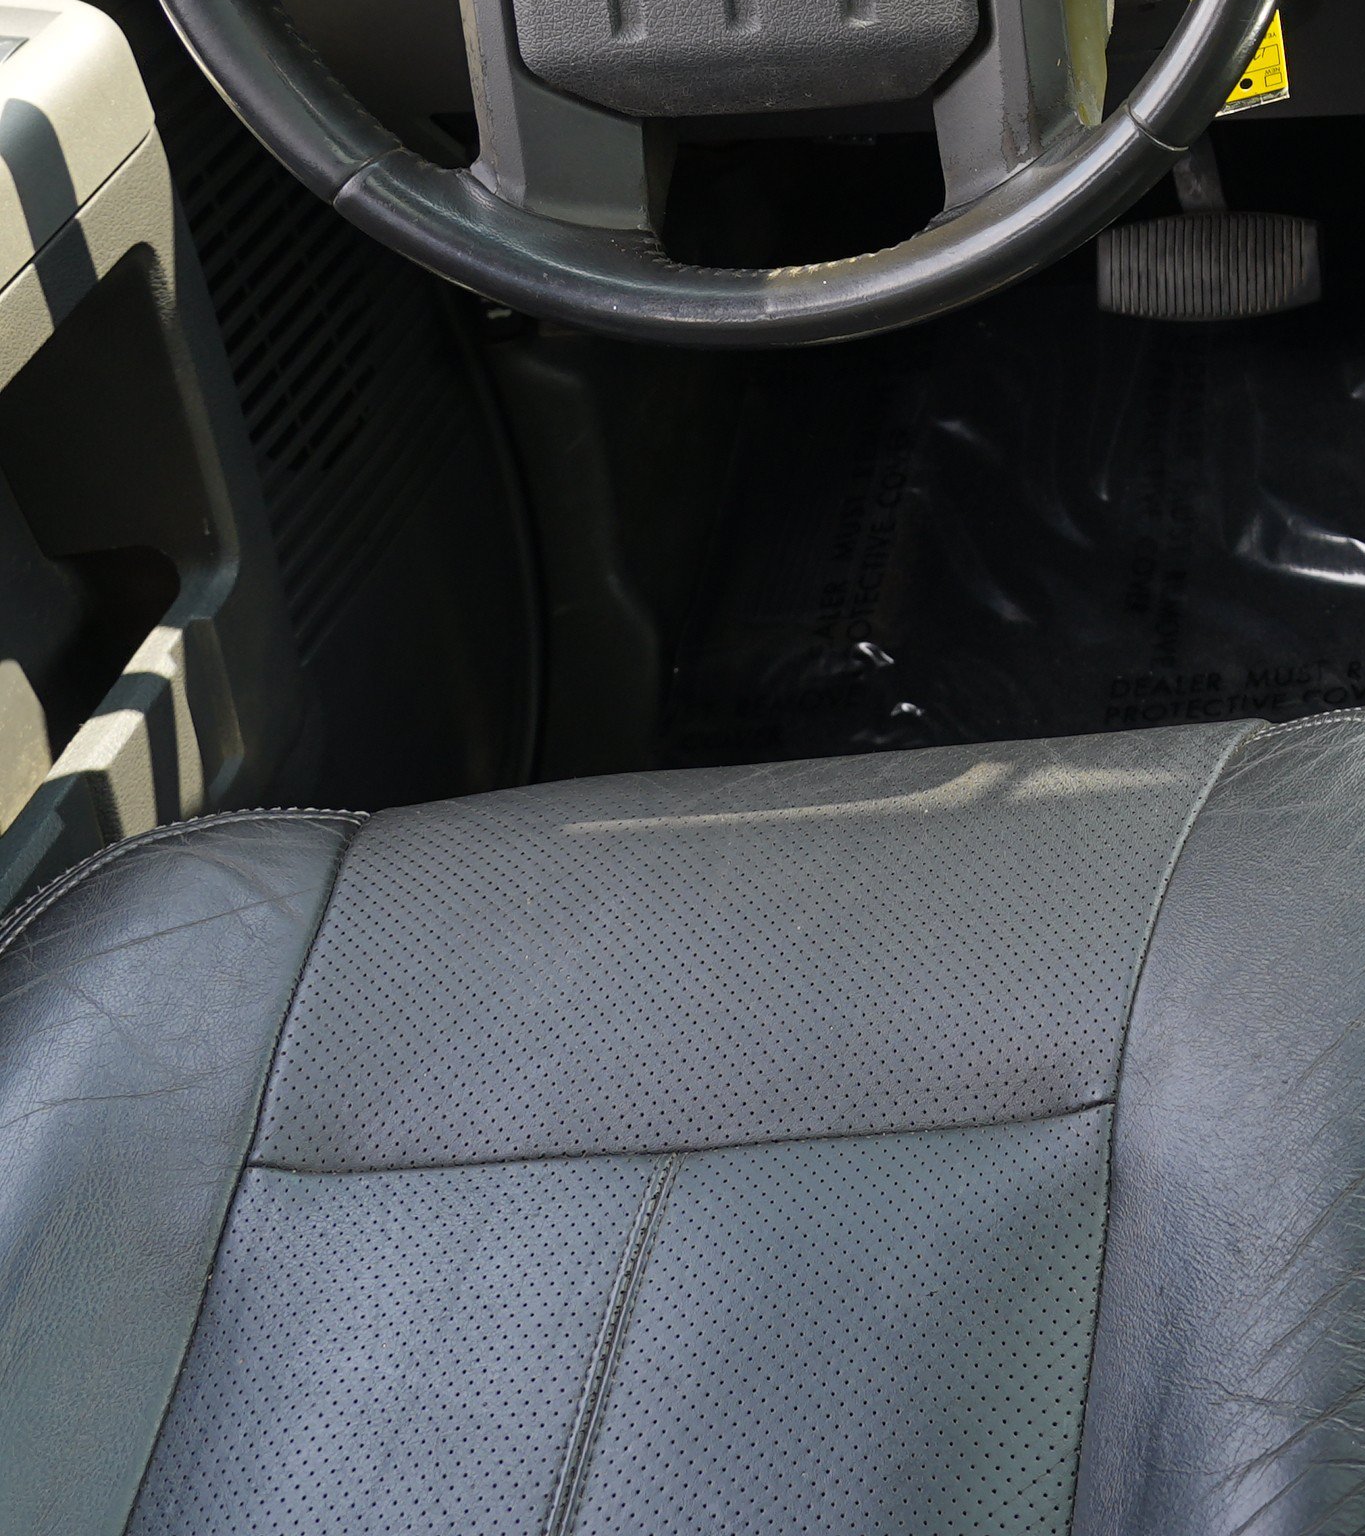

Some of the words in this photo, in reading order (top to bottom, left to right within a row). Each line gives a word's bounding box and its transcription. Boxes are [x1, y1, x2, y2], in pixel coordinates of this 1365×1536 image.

[1264, 66, 1281, 76] NEW
[1110, 673, 1224, 699] DEALER
[1244, 663, 1324, 688] MUST
[1103, 695, 1292, 726] PROTECTIVE
